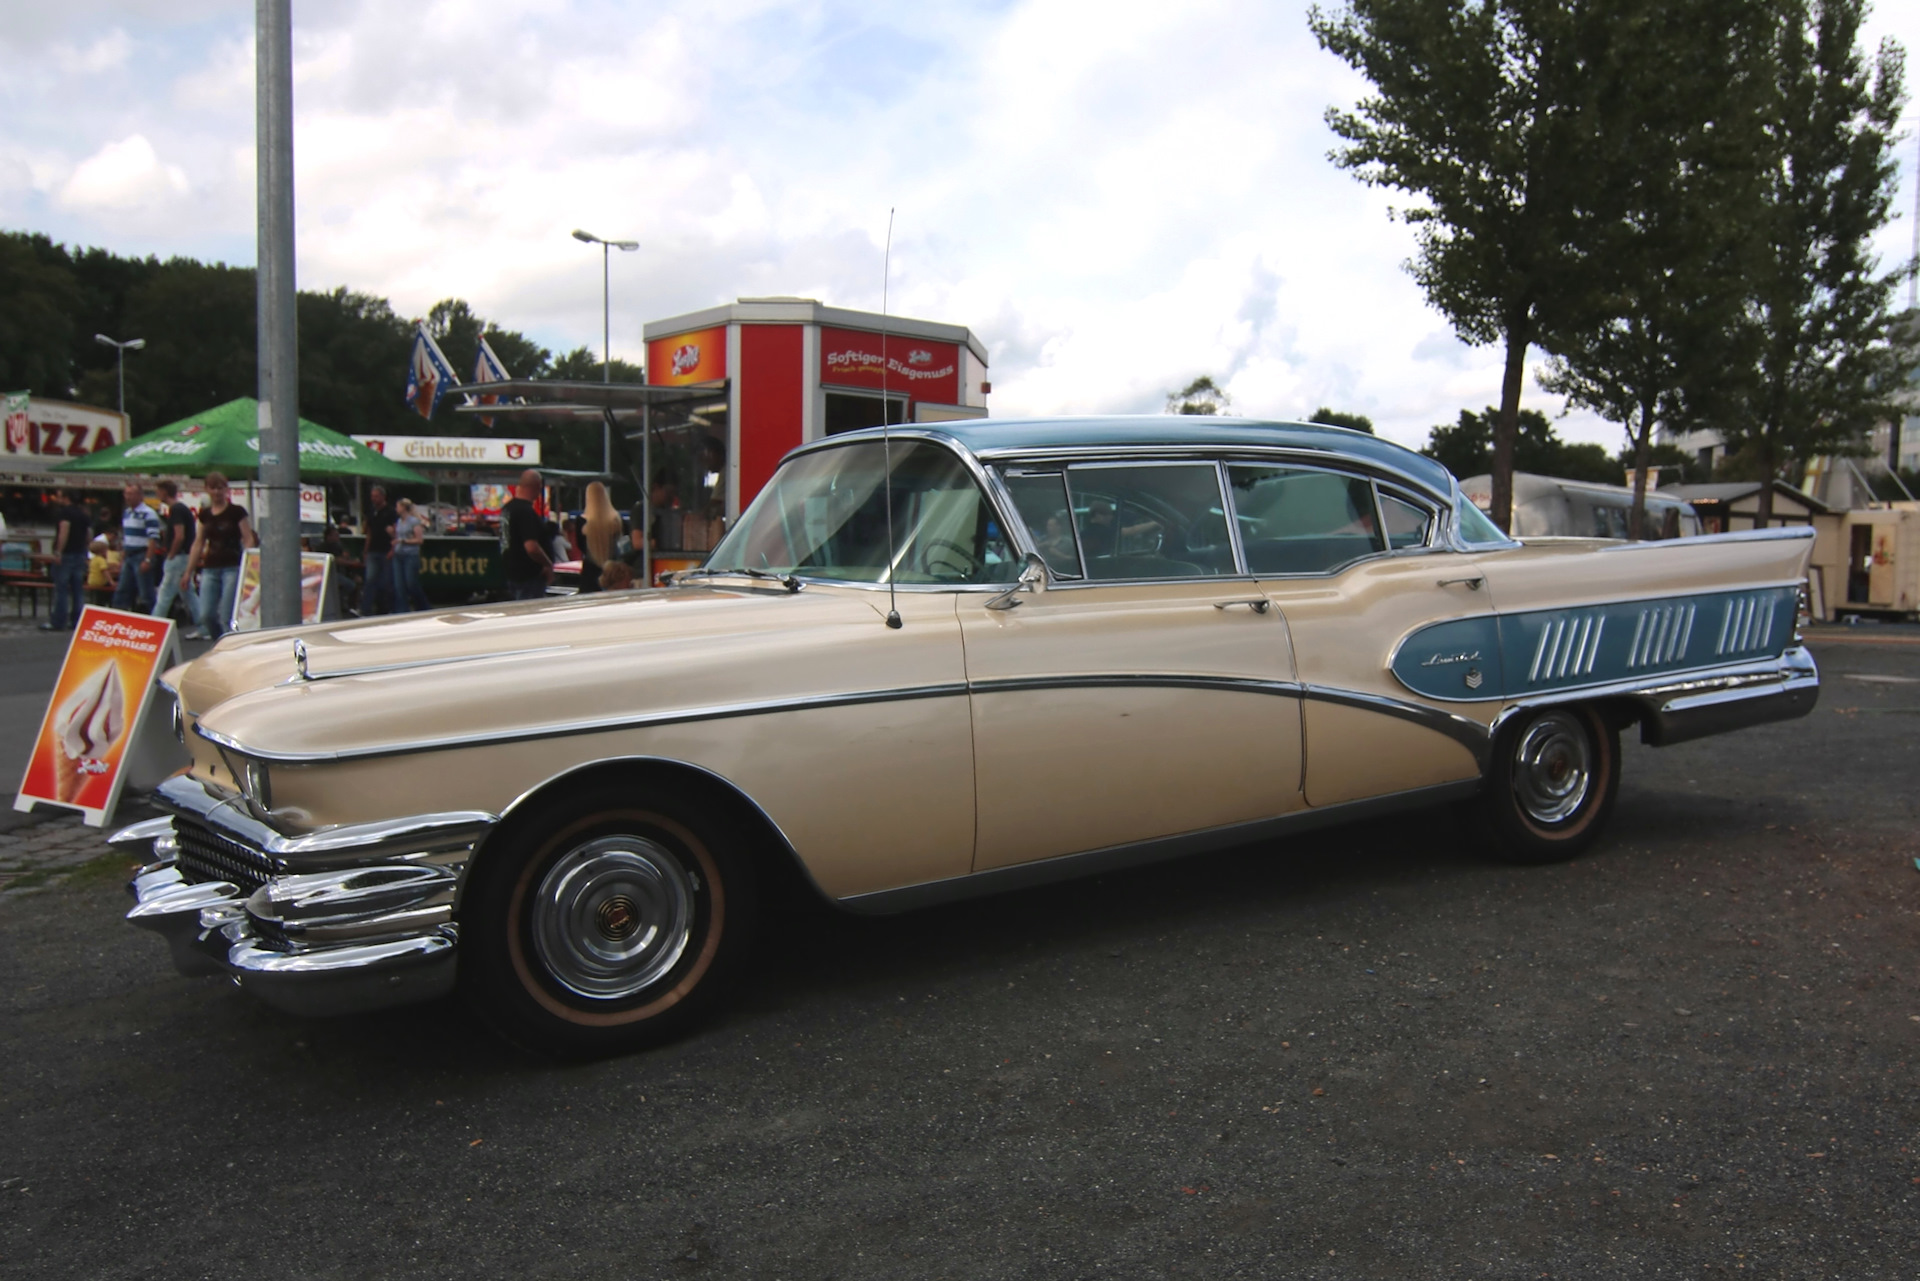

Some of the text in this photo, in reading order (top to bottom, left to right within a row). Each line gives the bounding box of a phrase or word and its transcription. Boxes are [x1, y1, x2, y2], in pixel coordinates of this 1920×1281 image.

[827, 350, 954, 380] Softiger Eisgenuss
[404, 441, 487, 459] Einbecker
[300, 490, 324, 503] OG
[92, 619, 155, 640] Softiger
[81, 629, 158, 653] Eisgenuss
